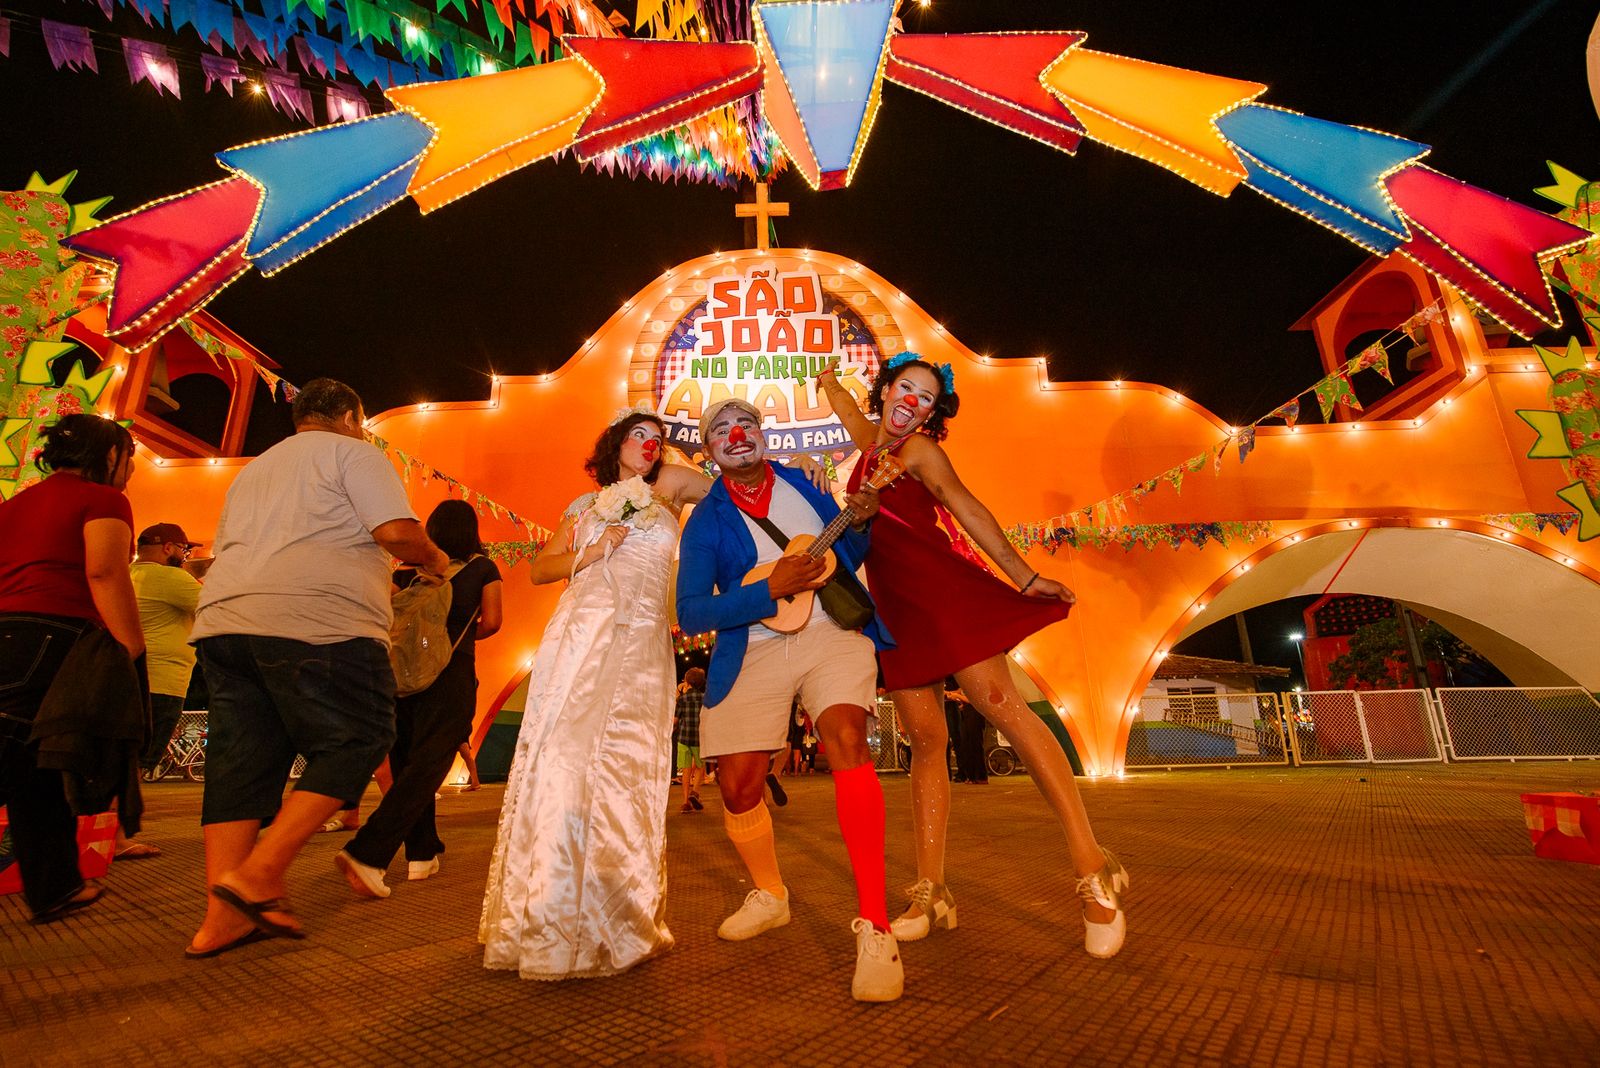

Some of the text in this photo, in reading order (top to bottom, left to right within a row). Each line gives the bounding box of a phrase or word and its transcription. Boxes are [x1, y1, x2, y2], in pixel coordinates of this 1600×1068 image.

[712, 270, 817, 319] SÃO
[701, 310, 834, 355] JOÃO
[691, 357, 728, 379] NO
[768, 433, 796, 450] DA
